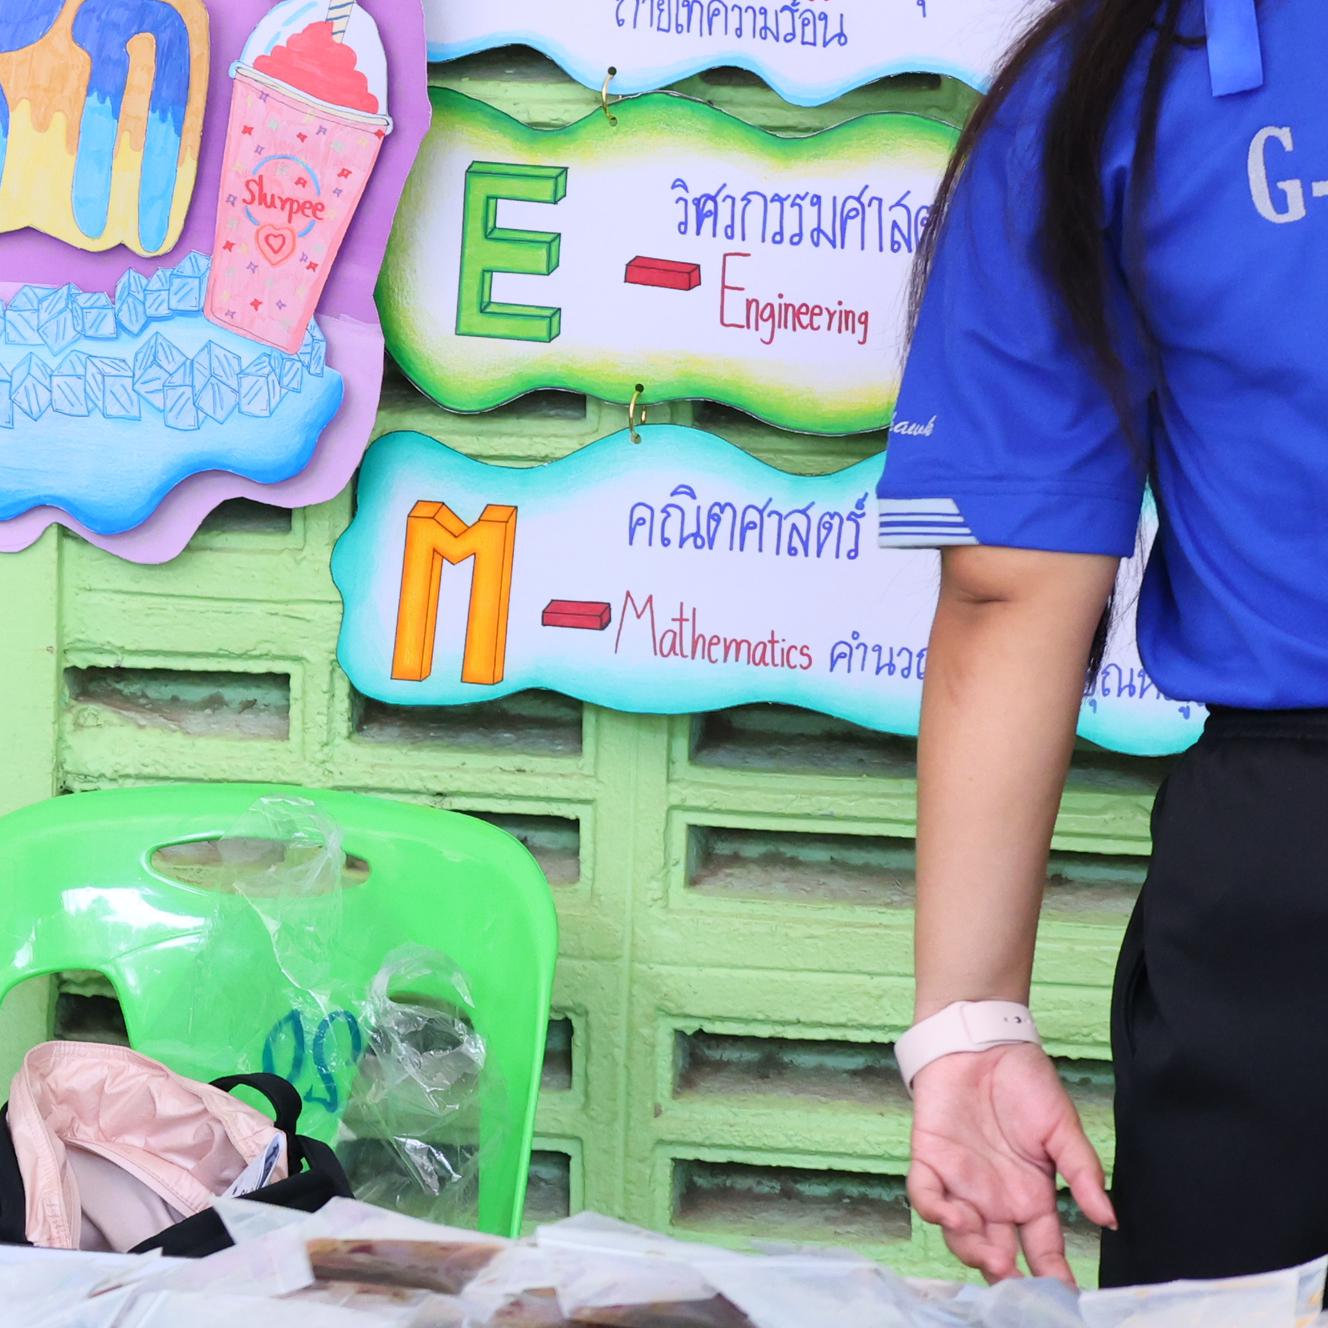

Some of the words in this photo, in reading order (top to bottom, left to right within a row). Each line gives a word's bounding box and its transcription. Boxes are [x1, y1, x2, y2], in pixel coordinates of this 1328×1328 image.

[455, 160, 569, 343] E
[719, 251, 870, 345] Engineering
[627, 483, 869, 561] คณิตศาสตร์
[390, 499, 519, 686] M
[614, 589, 813, 671] Mathematics
